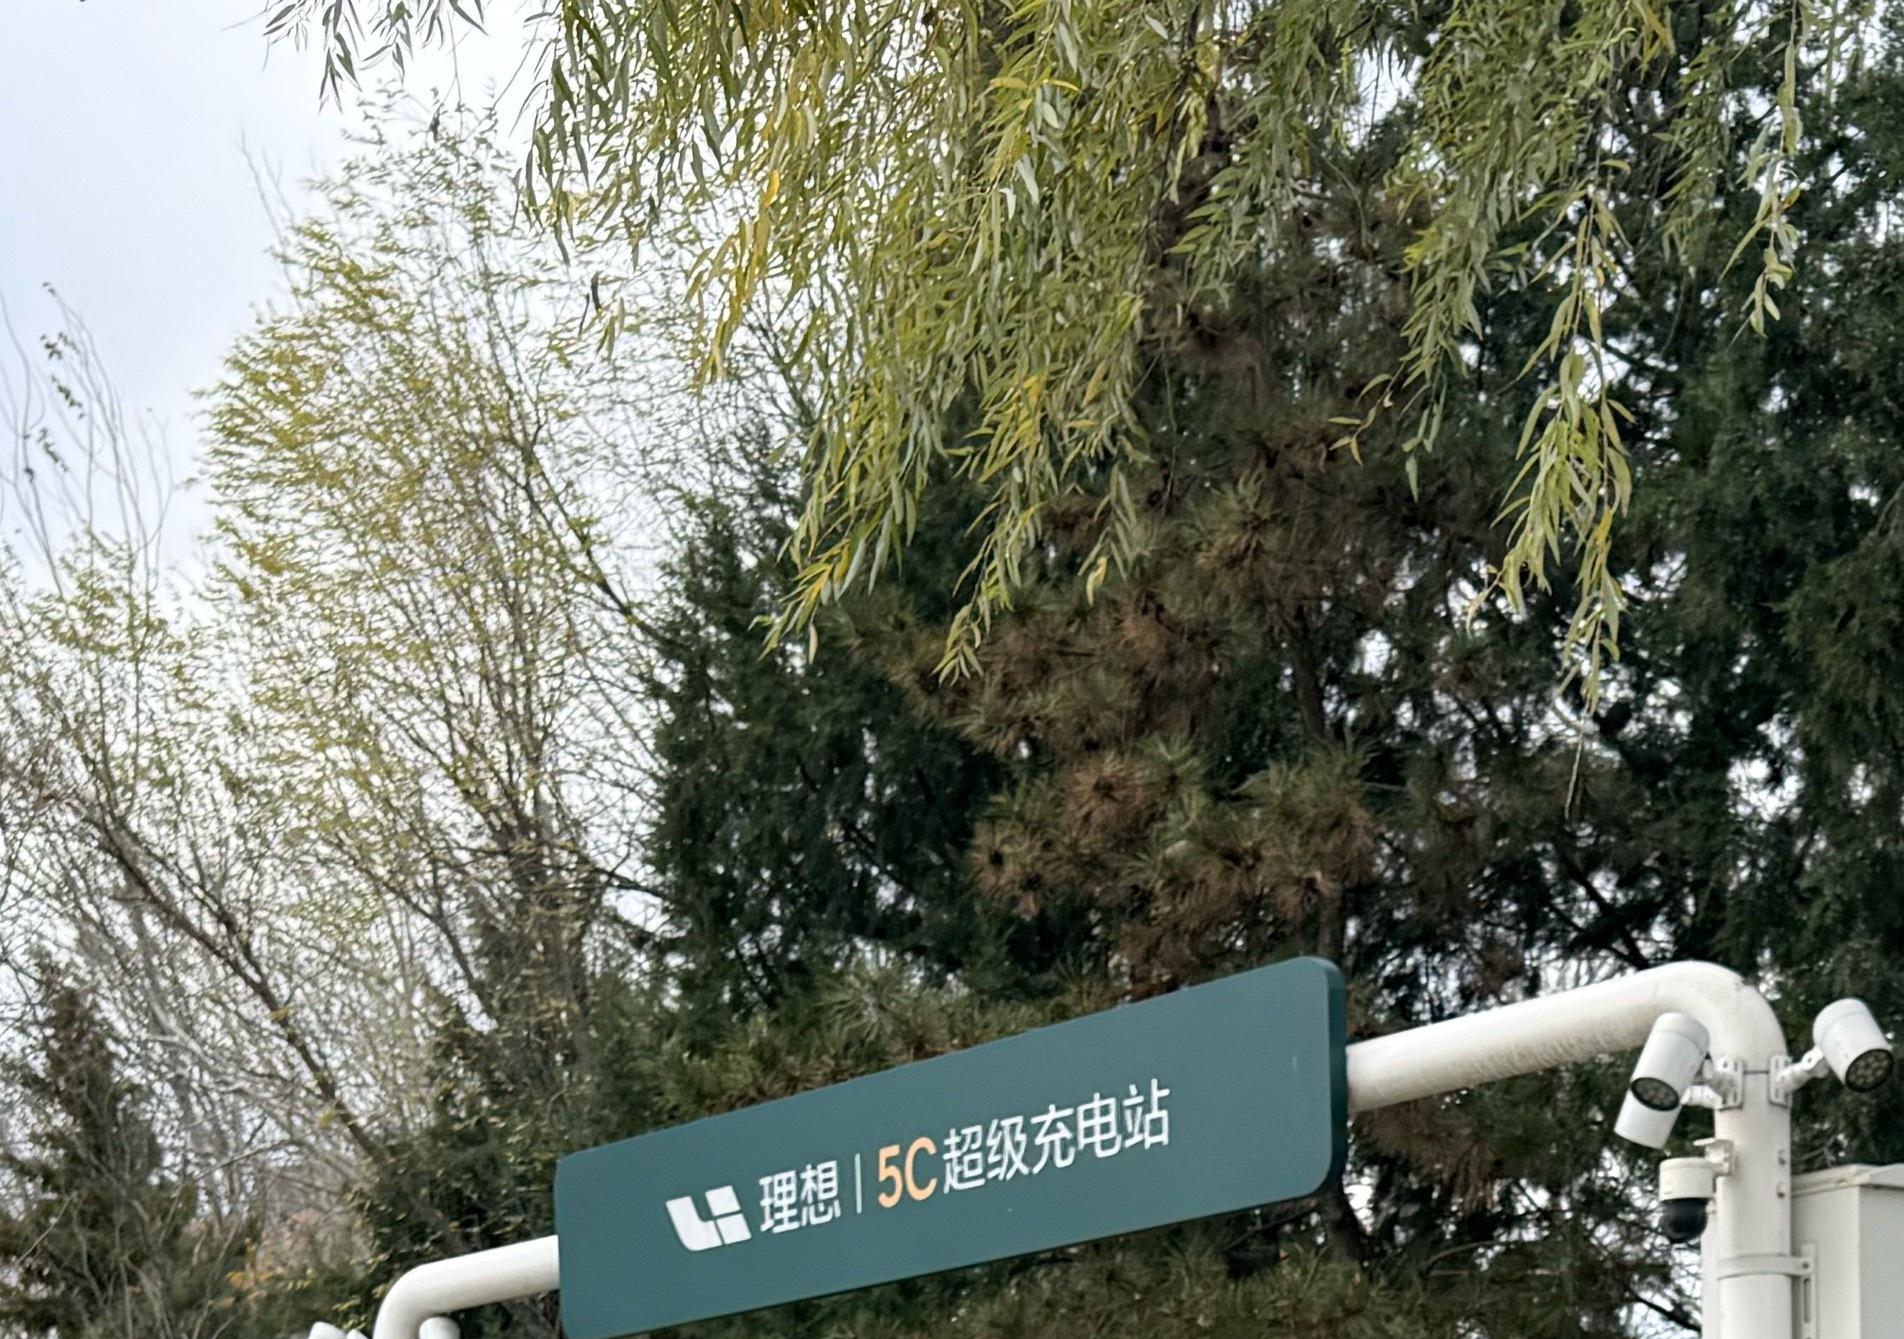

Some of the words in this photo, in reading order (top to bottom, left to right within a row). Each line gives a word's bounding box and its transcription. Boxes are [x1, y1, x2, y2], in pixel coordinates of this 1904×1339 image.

[758, 1160, 842, 1236] 理想
[875, 1078, 1172, 1210] 5C超级充电站
